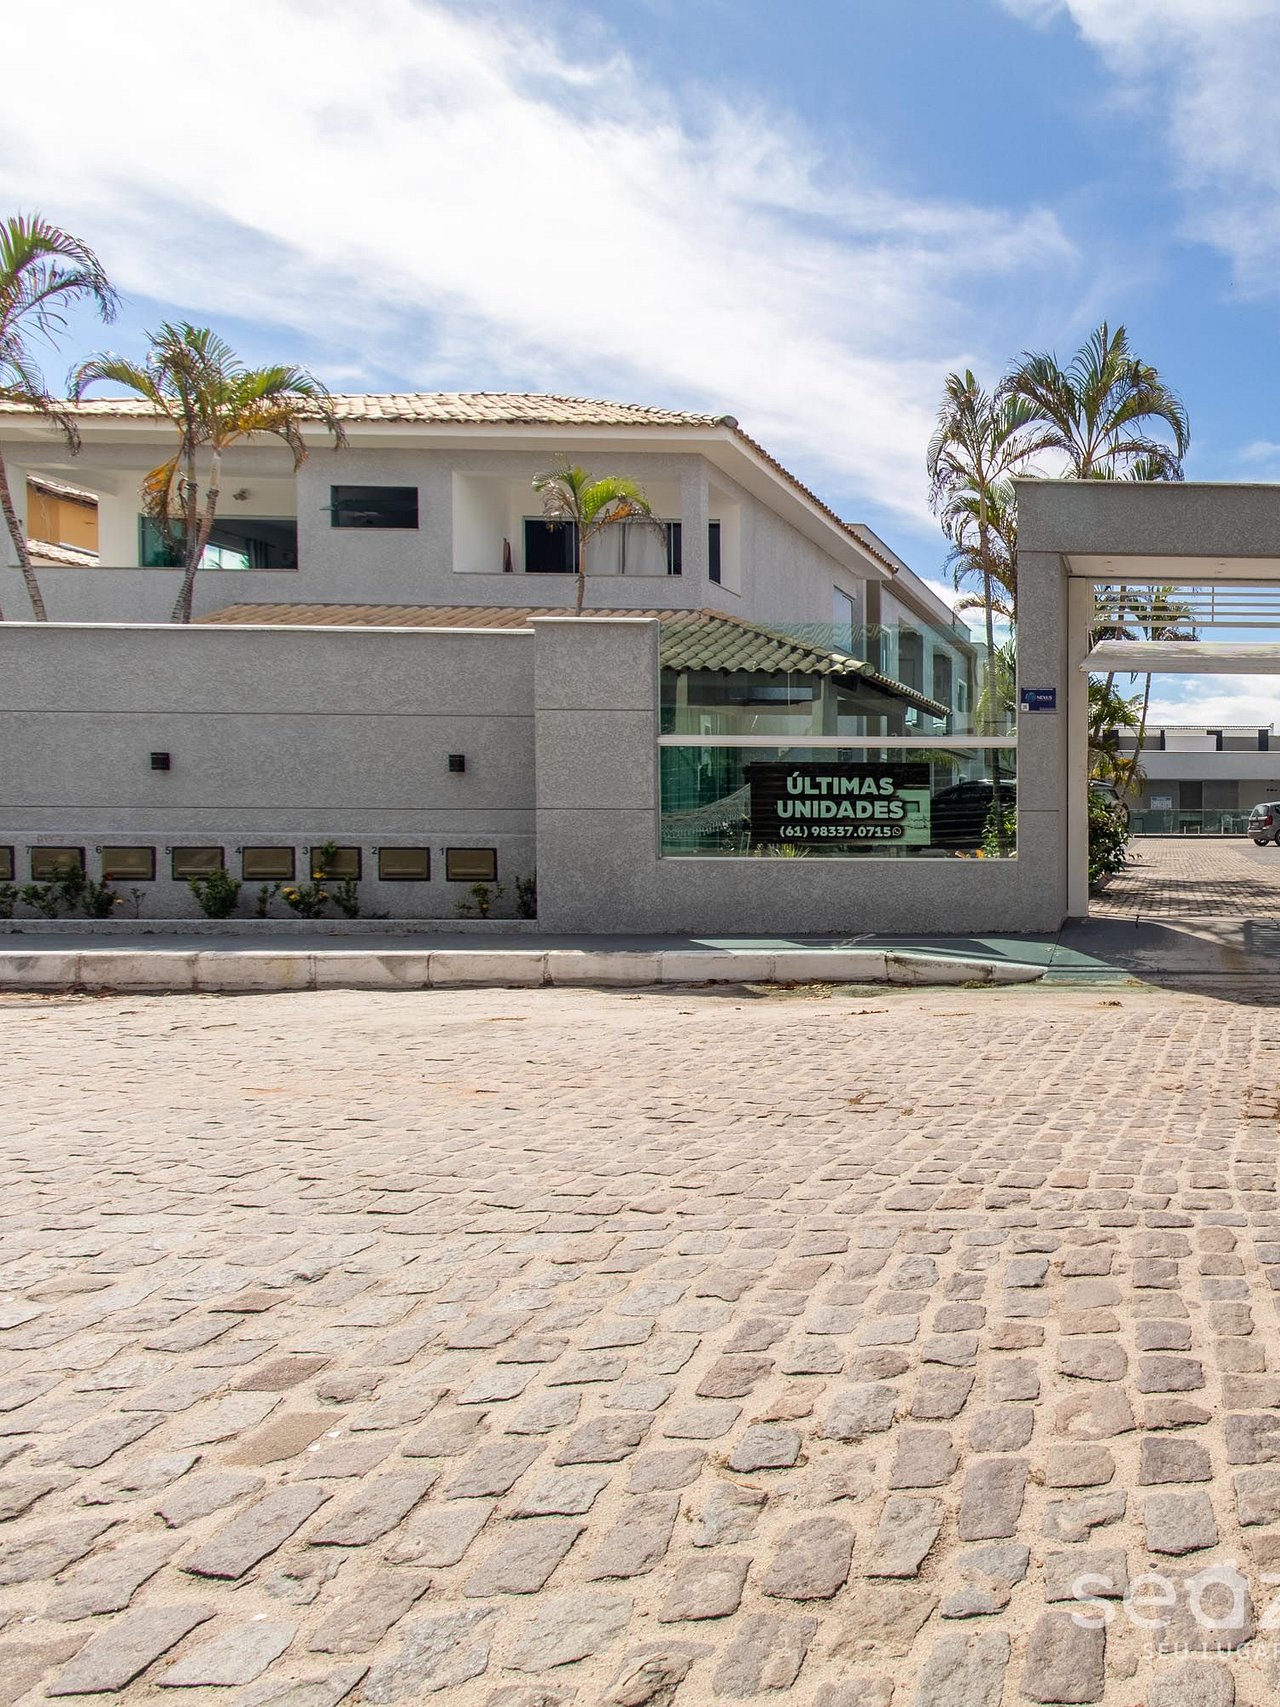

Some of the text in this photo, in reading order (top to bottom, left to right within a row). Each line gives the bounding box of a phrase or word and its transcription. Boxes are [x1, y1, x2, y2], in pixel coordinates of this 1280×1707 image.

[787, 772, 895, 795] ÚLTIMAS
[777, 800, 905, 819] UNIDADES
[779, 825, 892, 838] (61) 98337.0715
[26, 846, 32, 854] 7
[95, 846, 102, 854] 6
[165, 846, 172, 855] 5
[235, 846, 242, 855] 4
[302, 846, 309, 855] 3
[371, 846, 378, 855] 2
[439, 847, 445, 856] 1
